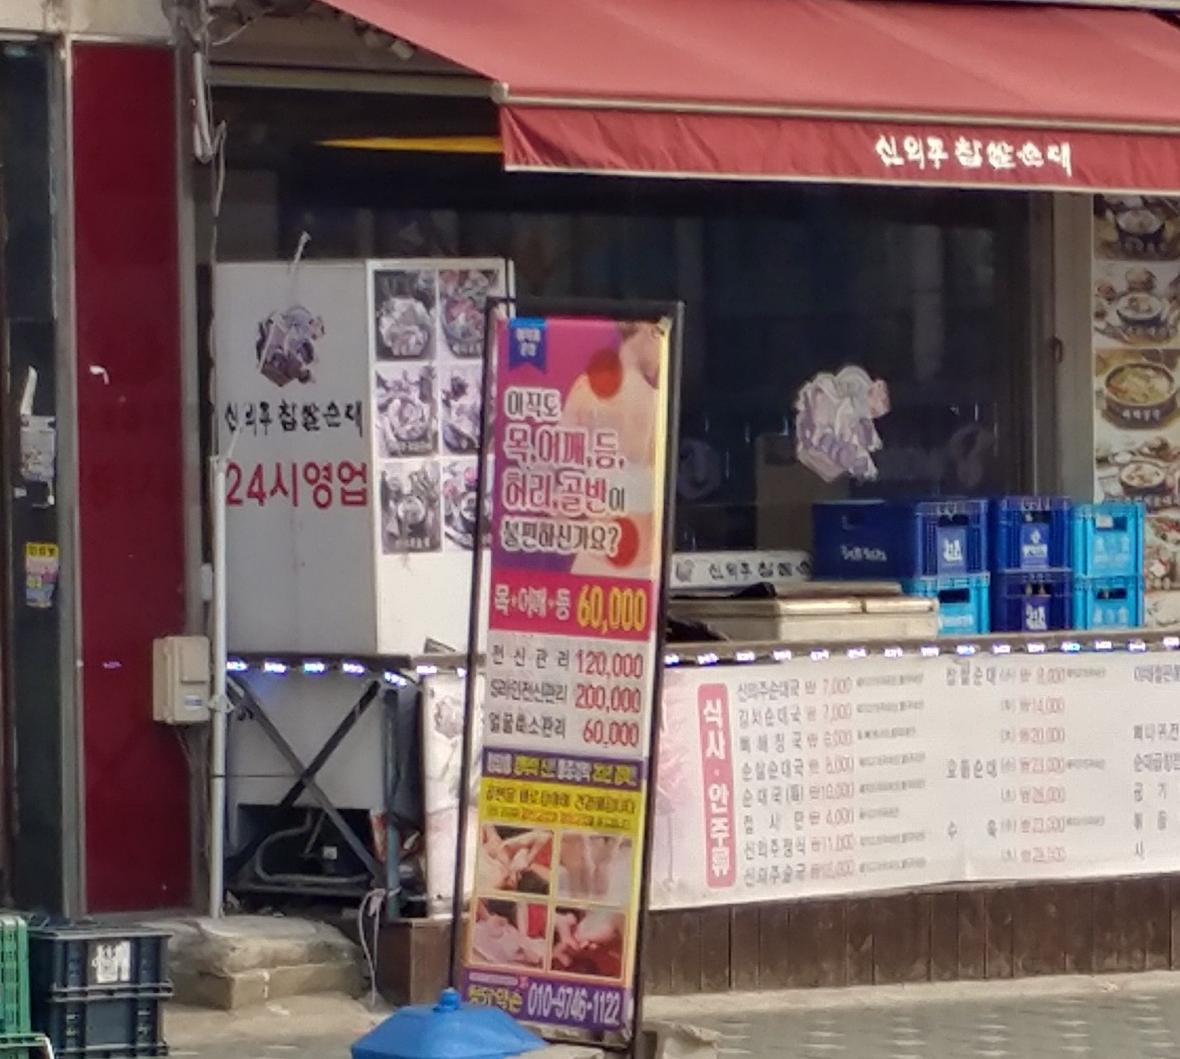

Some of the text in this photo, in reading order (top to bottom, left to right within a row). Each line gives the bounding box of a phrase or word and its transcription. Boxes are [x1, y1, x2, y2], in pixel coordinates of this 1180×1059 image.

[577, 584, 647, 634] 60,000
[575, 649, 643, 679] 120,000
[575, 683, 642, 713] 200,000
[582, 719, 640, 748] 60,000
